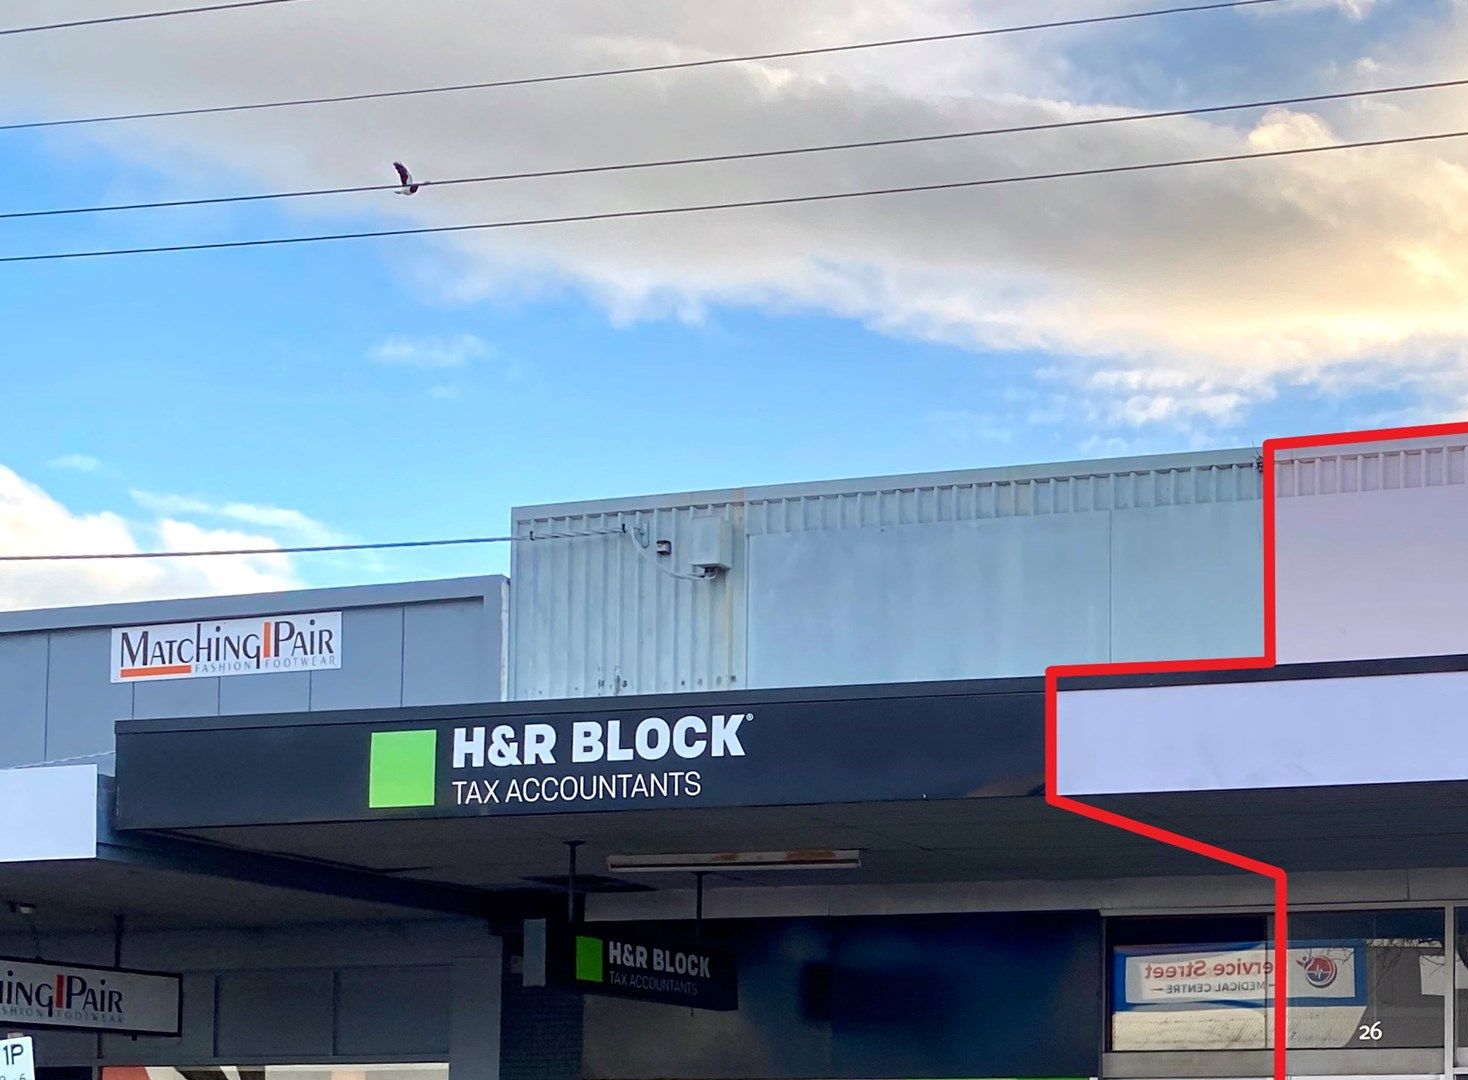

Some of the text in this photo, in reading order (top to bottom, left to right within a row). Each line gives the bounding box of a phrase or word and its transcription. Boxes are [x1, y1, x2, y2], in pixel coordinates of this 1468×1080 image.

[195, 655, 338, 673] FASHION FOOTWEAR
[452, 723, 557, 768] H&R
[452, 771, 701, 805] TAX ACCOUNTANTS
[608, 941, 711, 979] H&R BLOCK
[609, 971, 698, 997] TAX ACCOUNTANTS
[1359, 1020, 1383, 1040] 26
[3, 1044, 24, 1065] 1P
